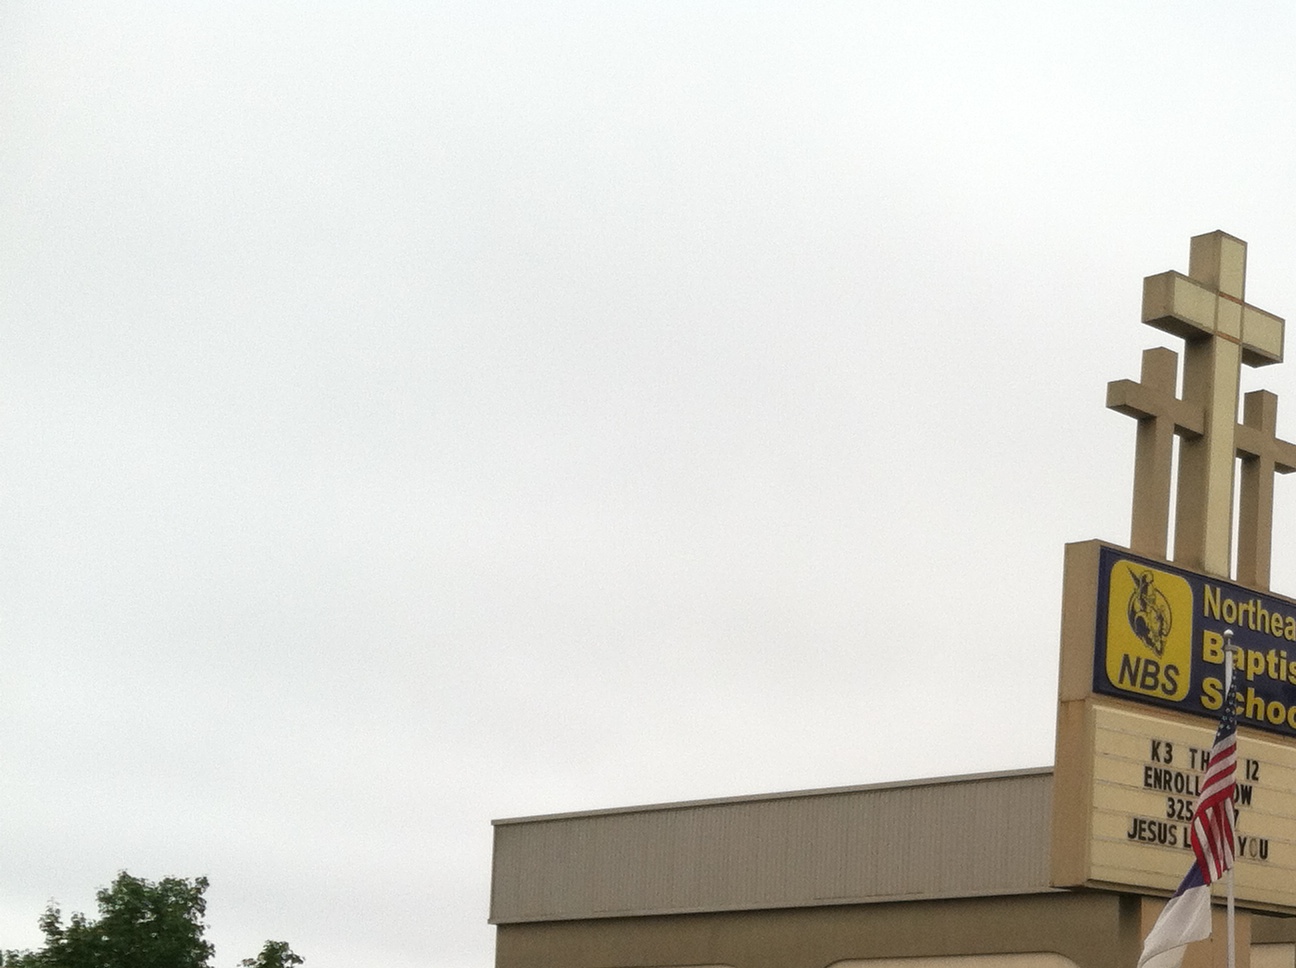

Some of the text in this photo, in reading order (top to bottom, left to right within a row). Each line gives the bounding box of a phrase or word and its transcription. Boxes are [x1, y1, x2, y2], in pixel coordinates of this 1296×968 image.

[1118, 653, 1181, 697] NBS
[1151, 739, 1173, 765] K3
[1246, 759, 1260, 782] 12
[1127, 817, 1178, 846] JESUS
